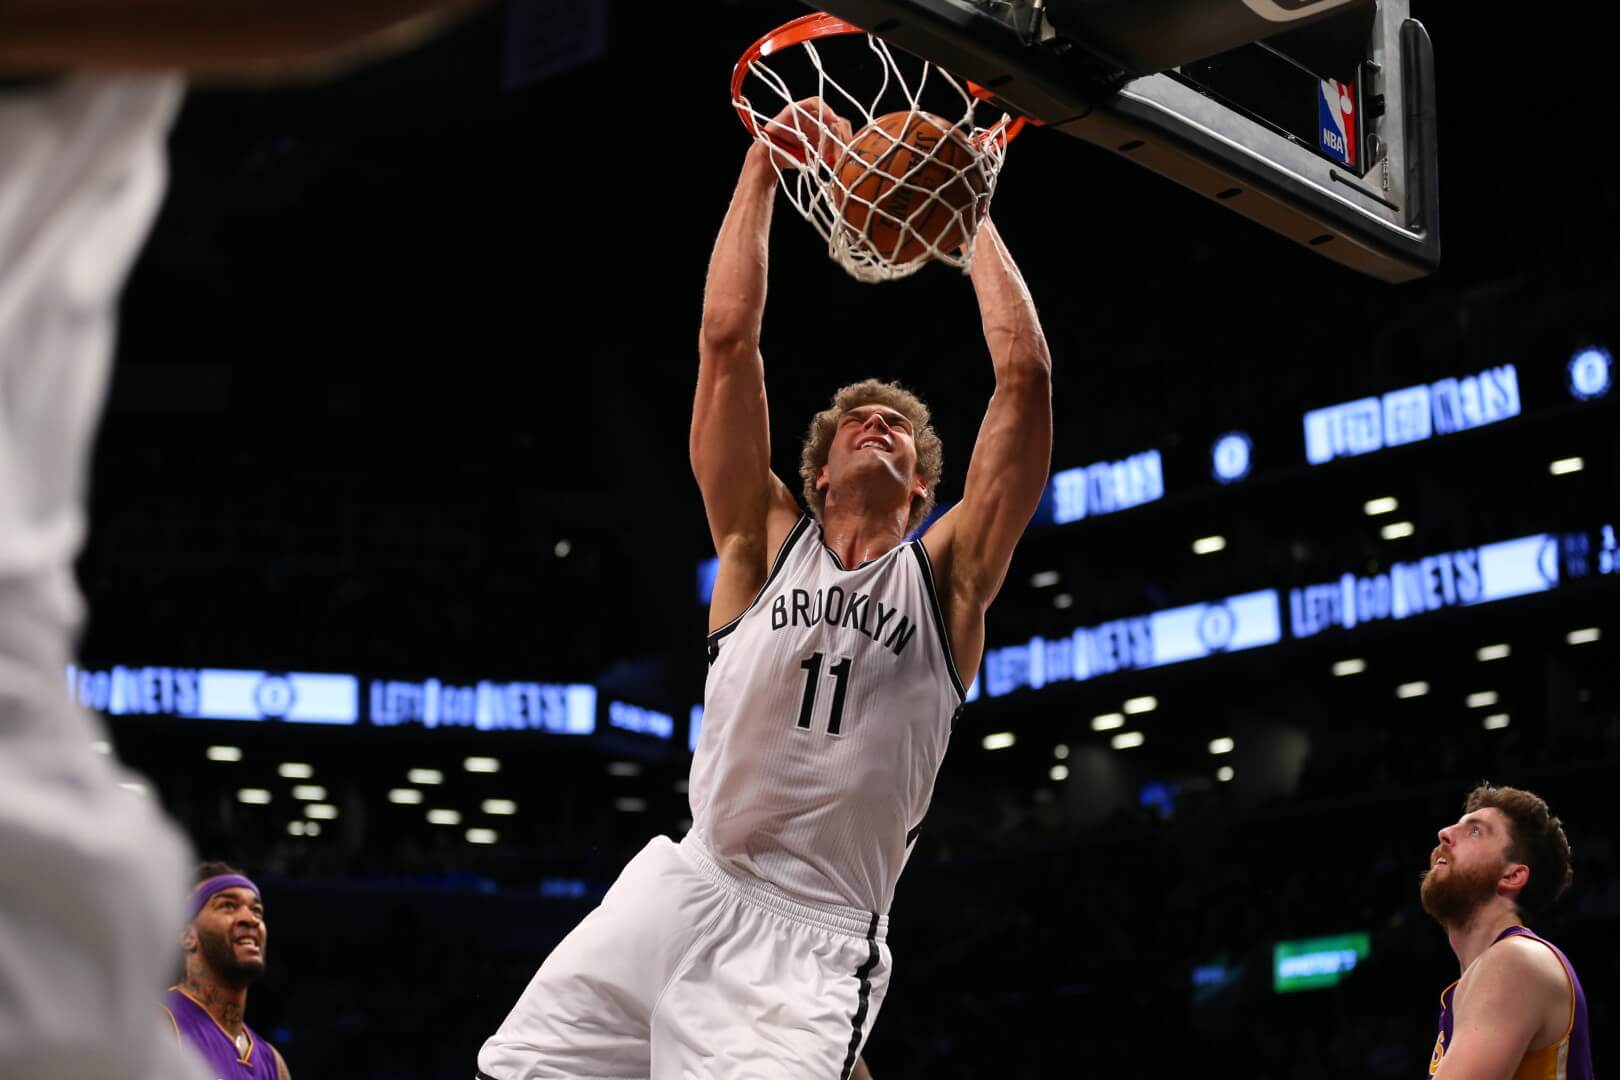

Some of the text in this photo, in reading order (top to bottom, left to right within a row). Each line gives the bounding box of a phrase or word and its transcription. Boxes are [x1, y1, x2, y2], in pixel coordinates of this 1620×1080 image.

[1323, 128, 1344, 154] NBA
[772, 585, 917, 656] BROOKLYN
[796, 650, 854, 737] 11
